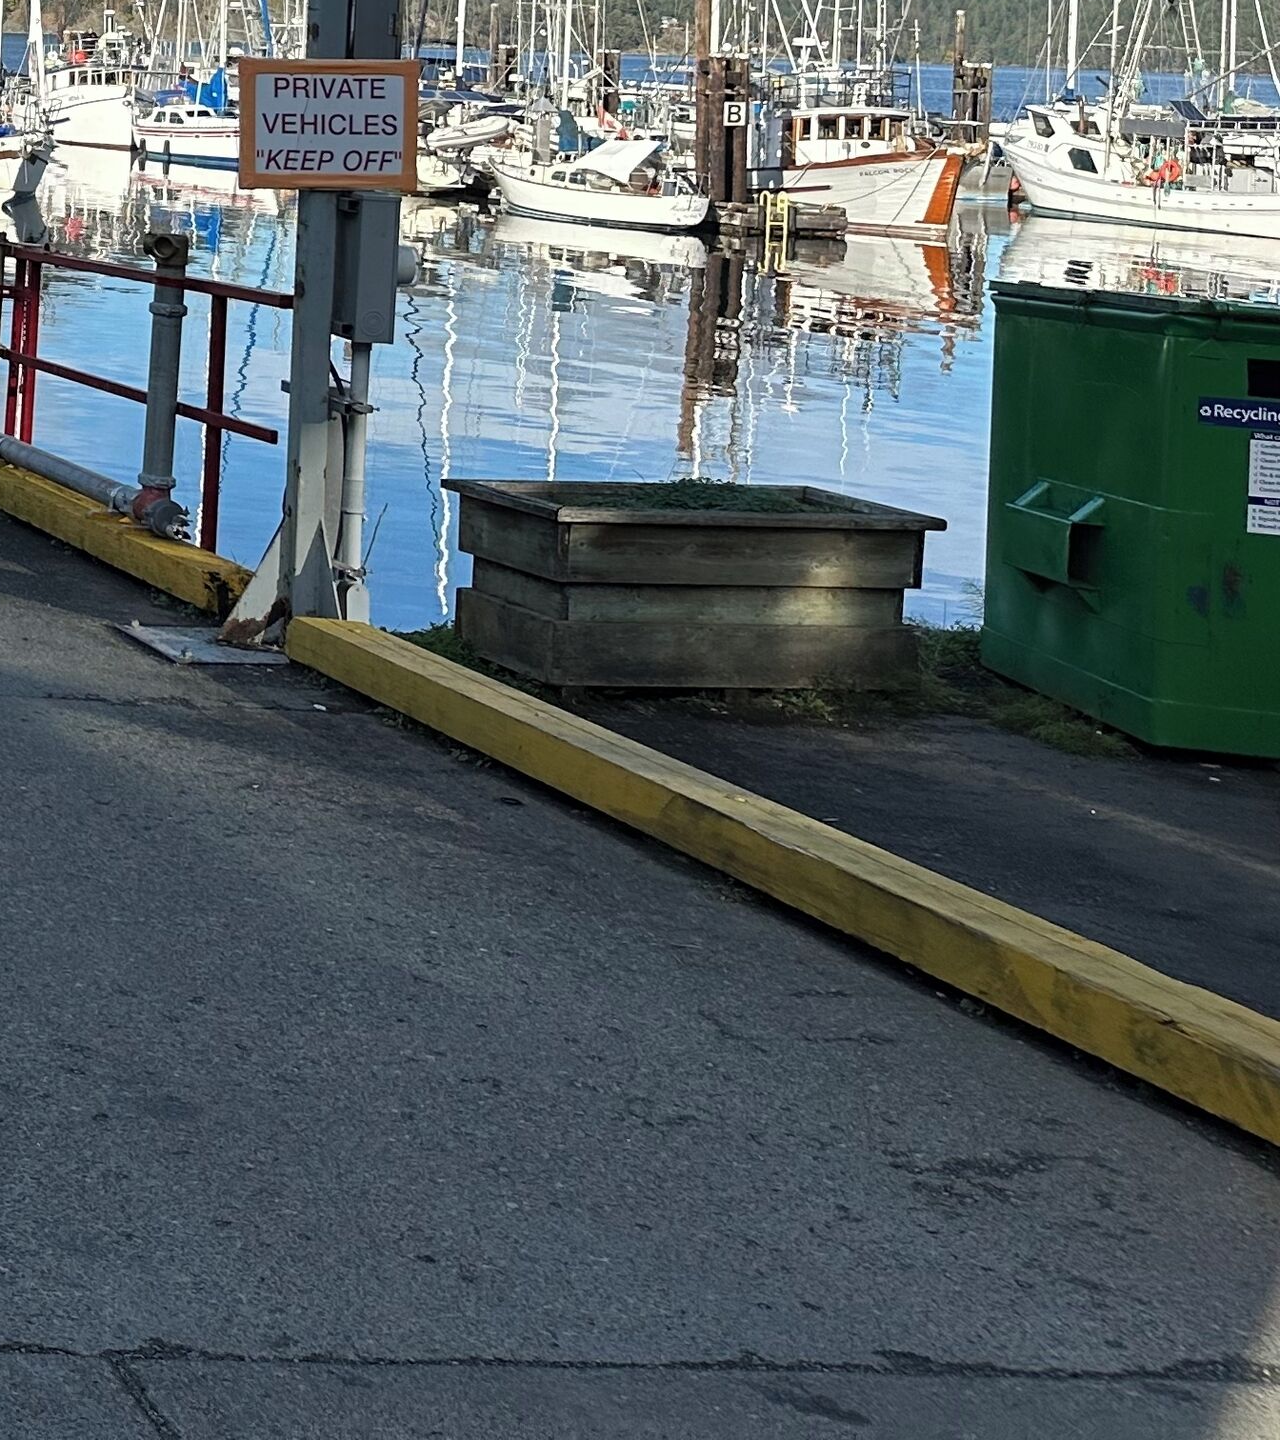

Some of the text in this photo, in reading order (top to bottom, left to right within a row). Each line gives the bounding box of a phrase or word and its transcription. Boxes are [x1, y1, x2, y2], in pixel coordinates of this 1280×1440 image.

[274, 77, 386, 99] PRIVATE
[262, 113, 398, 136] VEHICLES
[728, 104, 742, 123] B
